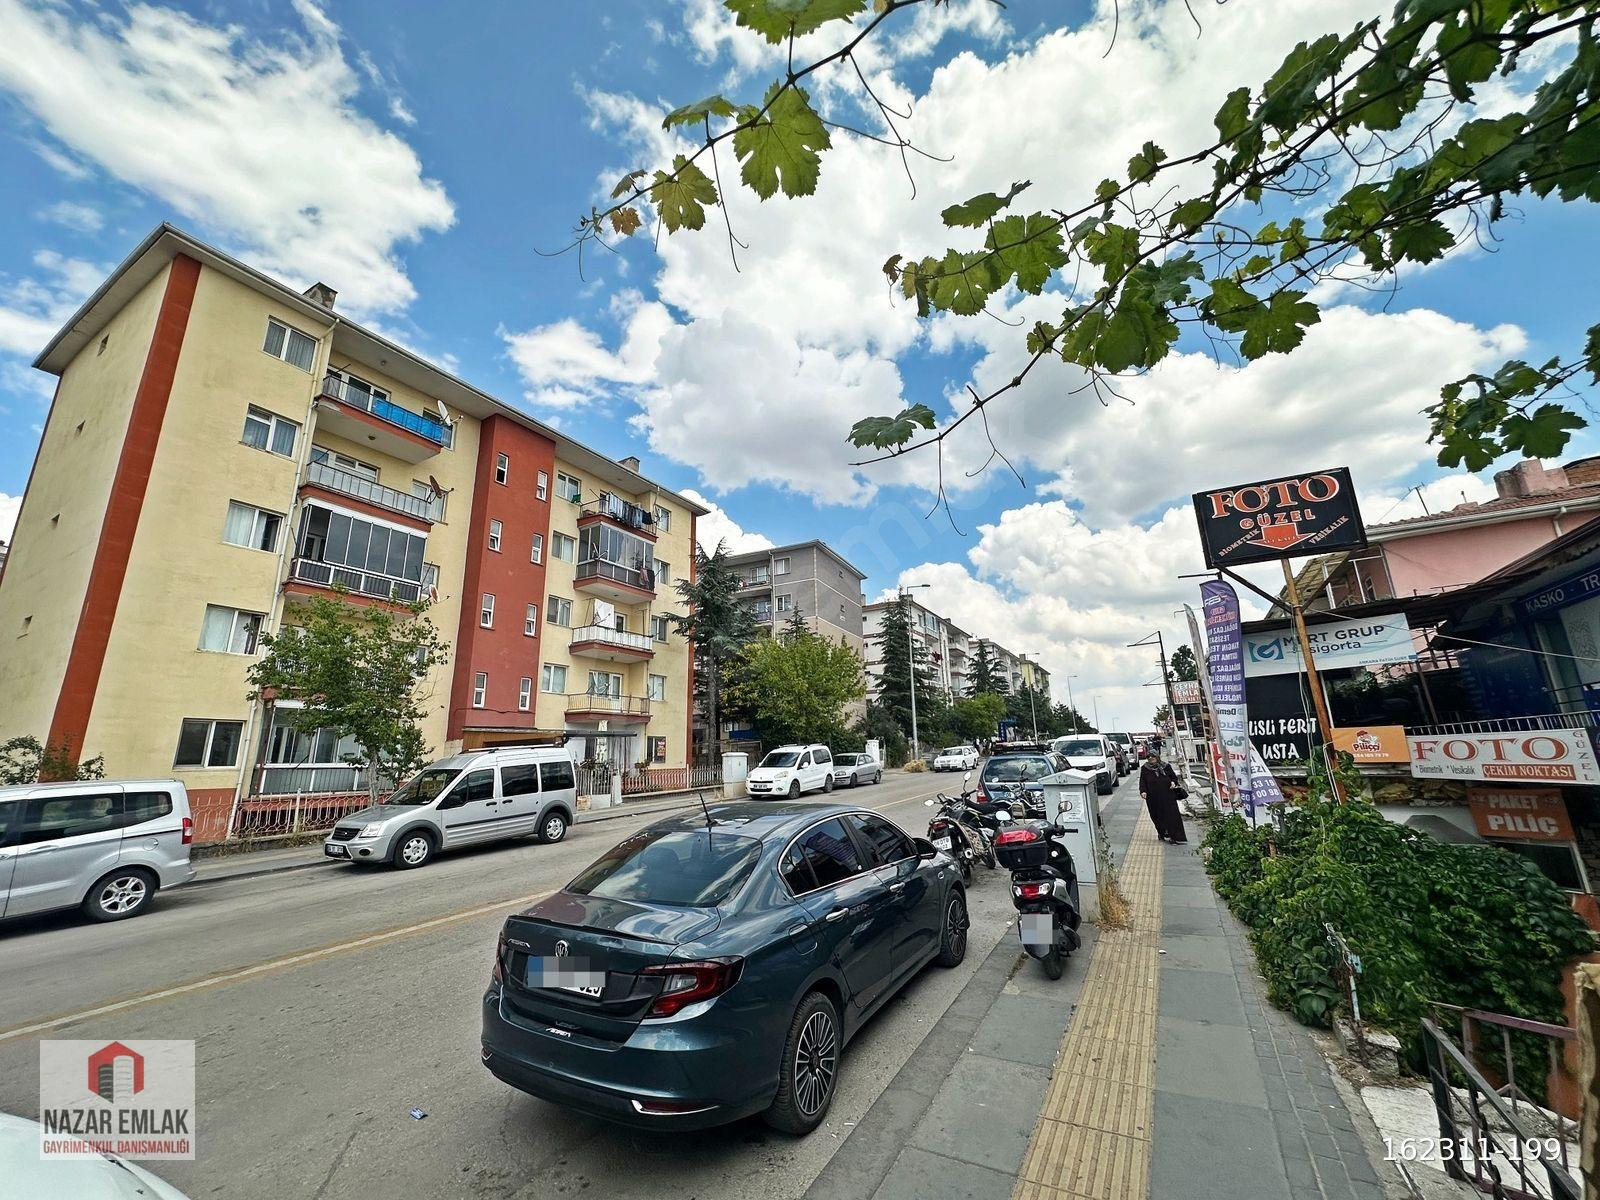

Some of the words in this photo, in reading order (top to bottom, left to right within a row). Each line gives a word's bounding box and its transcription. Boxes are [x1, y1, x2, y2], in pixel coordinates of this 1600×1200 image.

[1207, 474, 1340, 518] FOTO
[1240, 509, 1316, 530] GÜZEL
[1525, 588, 1564, 613] KASKO
[1335, 625, 1385, 640] GRUP
[1309, 640, 1361, 655] sigorta
[1262, 743, 1300, 760] USTA
[1414, 736, 1569, 761] FOTO
[1573, 730, 1595, 781] GÜZEL
[1483, 764, 1517, 778] ÇEKİM
[1520, 766, 1573, 778] NOKTASI
[1487, 795, 1538, 809] PAKET
[1487, 813, 1559, 836] PİLİÇ
